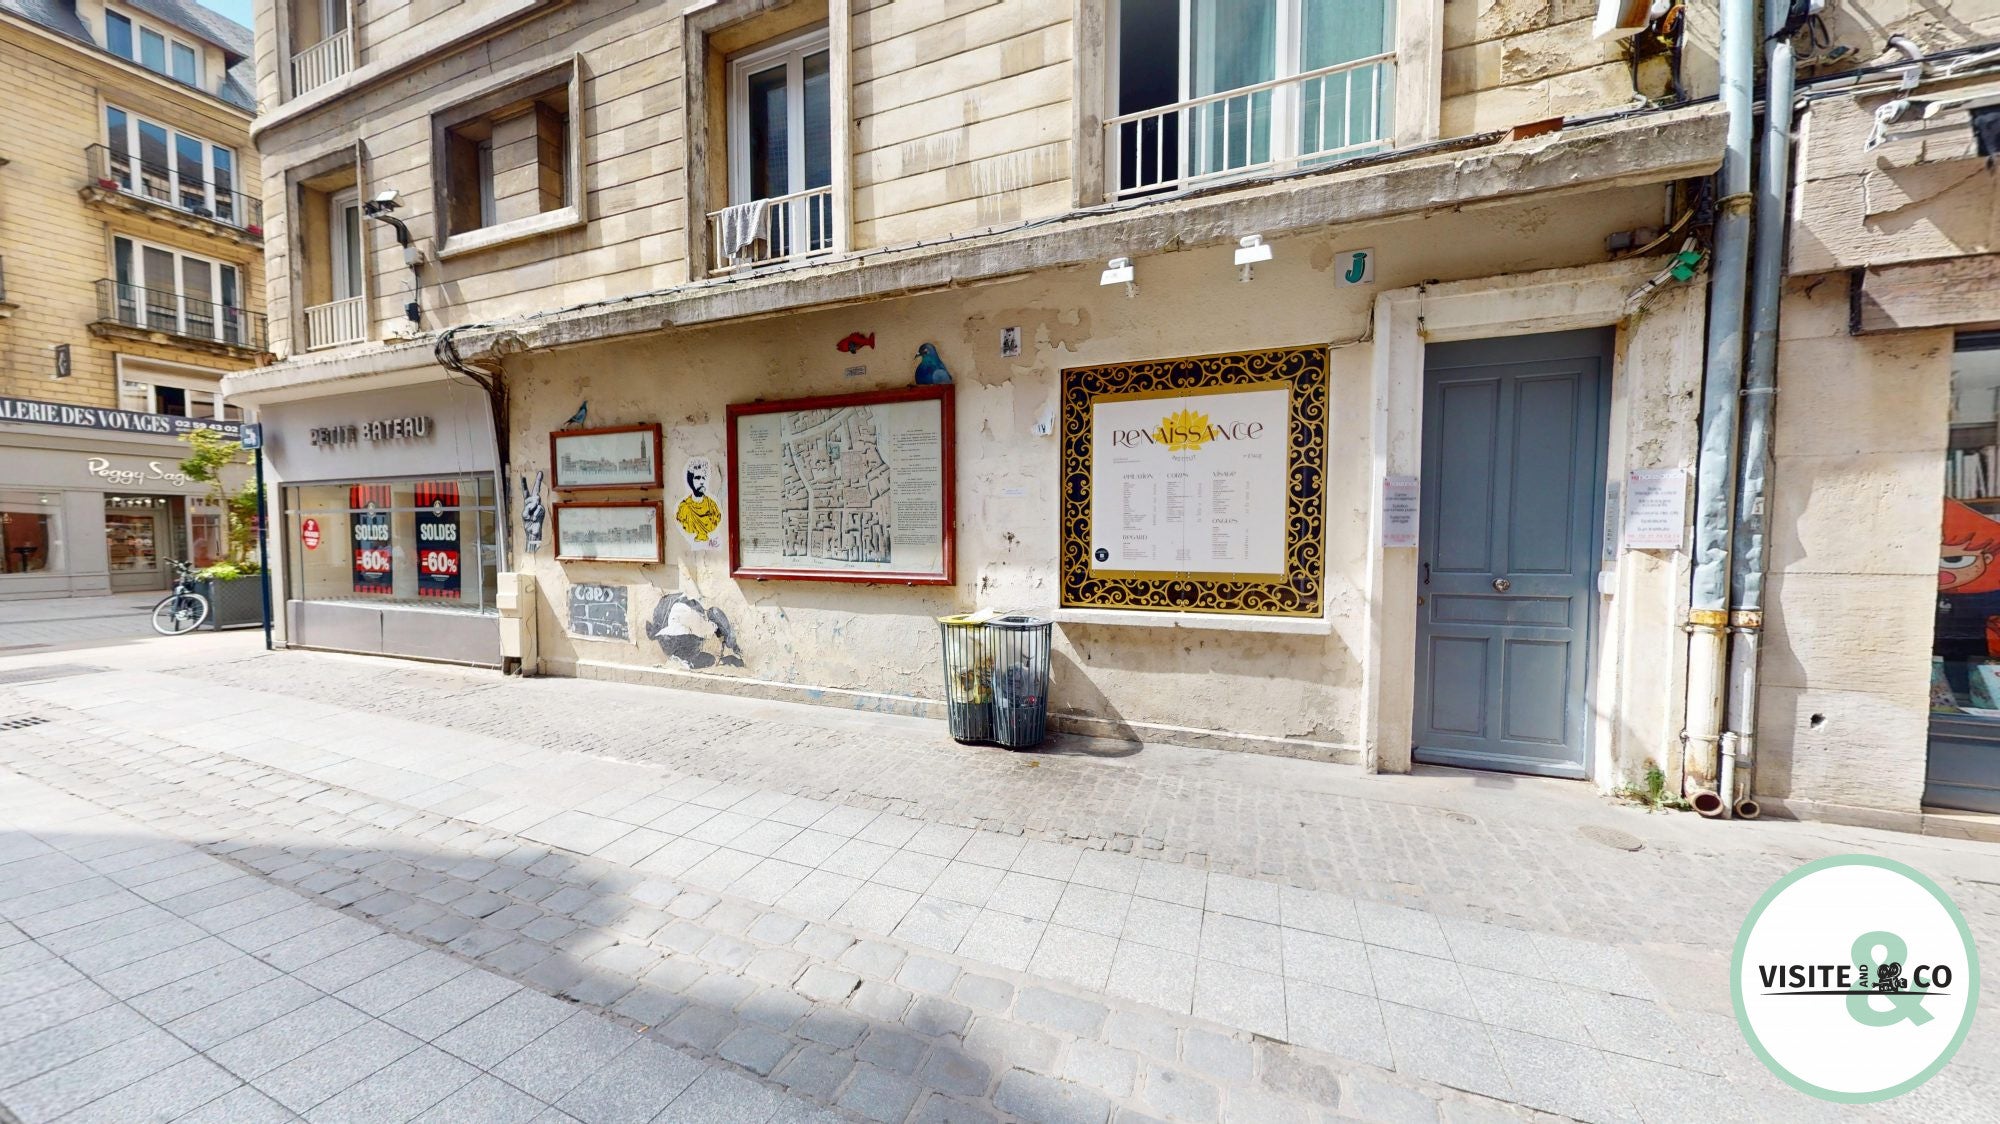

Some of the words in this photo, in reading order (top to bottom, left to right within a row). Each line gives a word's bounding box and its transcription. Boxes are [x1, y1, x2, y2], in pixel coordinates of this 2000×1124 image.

[62, 406, 96, 426] DES
[97, 410, 171, 433] VOYAGES
[362, 416, 430, 441] BATEAU
[87, 457, 145, 485] Peggy
[355, 524, 388, 541] SOLDES
[420, 522, 457, 542] SOLDES
